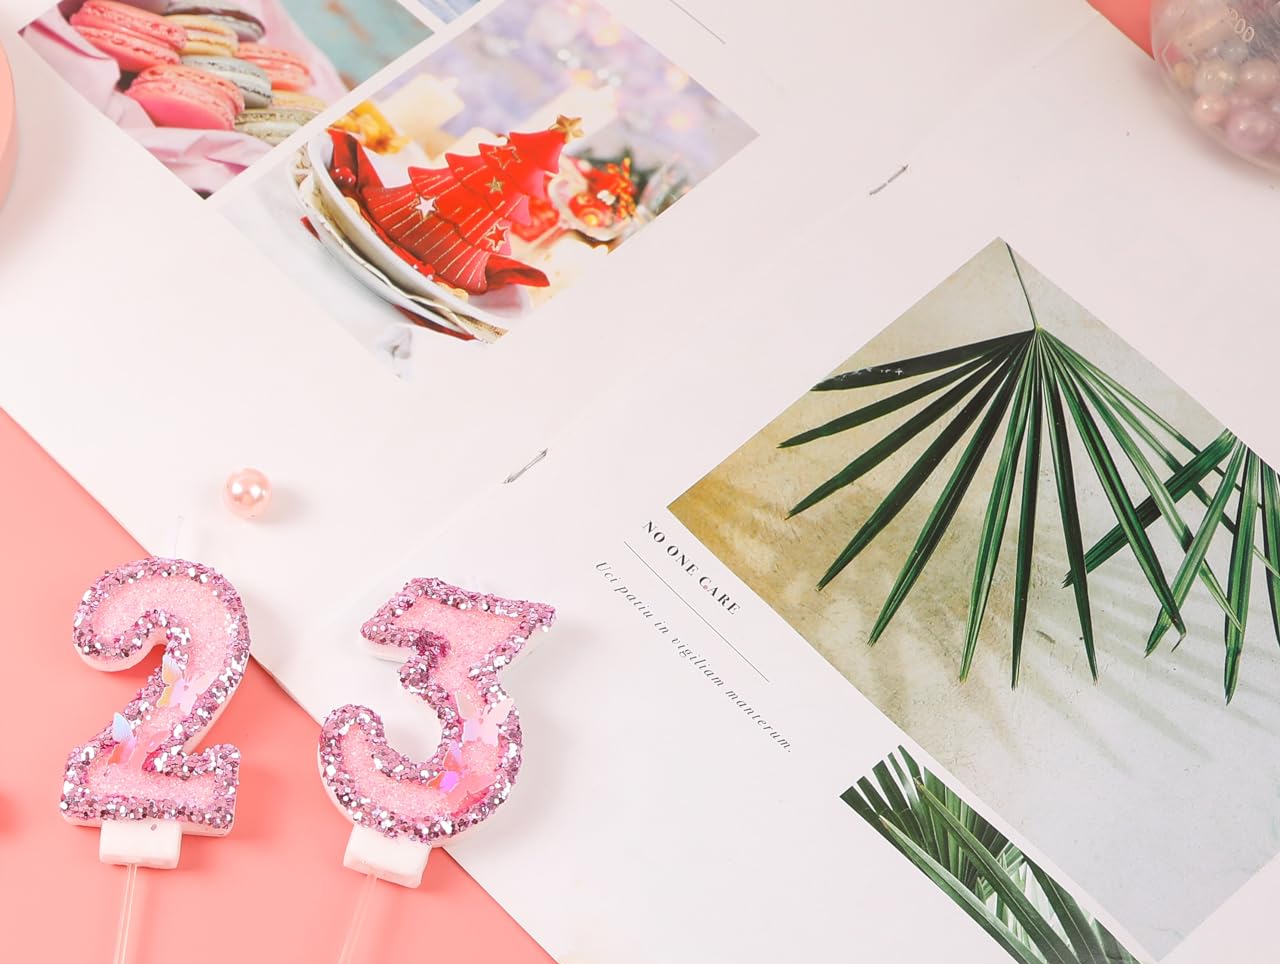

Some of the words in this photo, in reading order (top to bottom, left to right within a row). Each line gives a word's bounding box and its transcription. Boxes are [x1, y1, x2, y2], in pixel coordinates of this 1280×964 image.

[596, 562, 621, 582] Uci
[654, 620, 670, 634] in
[671, 637, 724, 687] vigiliam
[642, 520, 666, 543] NO
[667, 545, 699, 576] ONE
[699, 576, 741, 615] CARE
[59, 557, 250, 837] 2
[317, 577, 556, 847] 3
